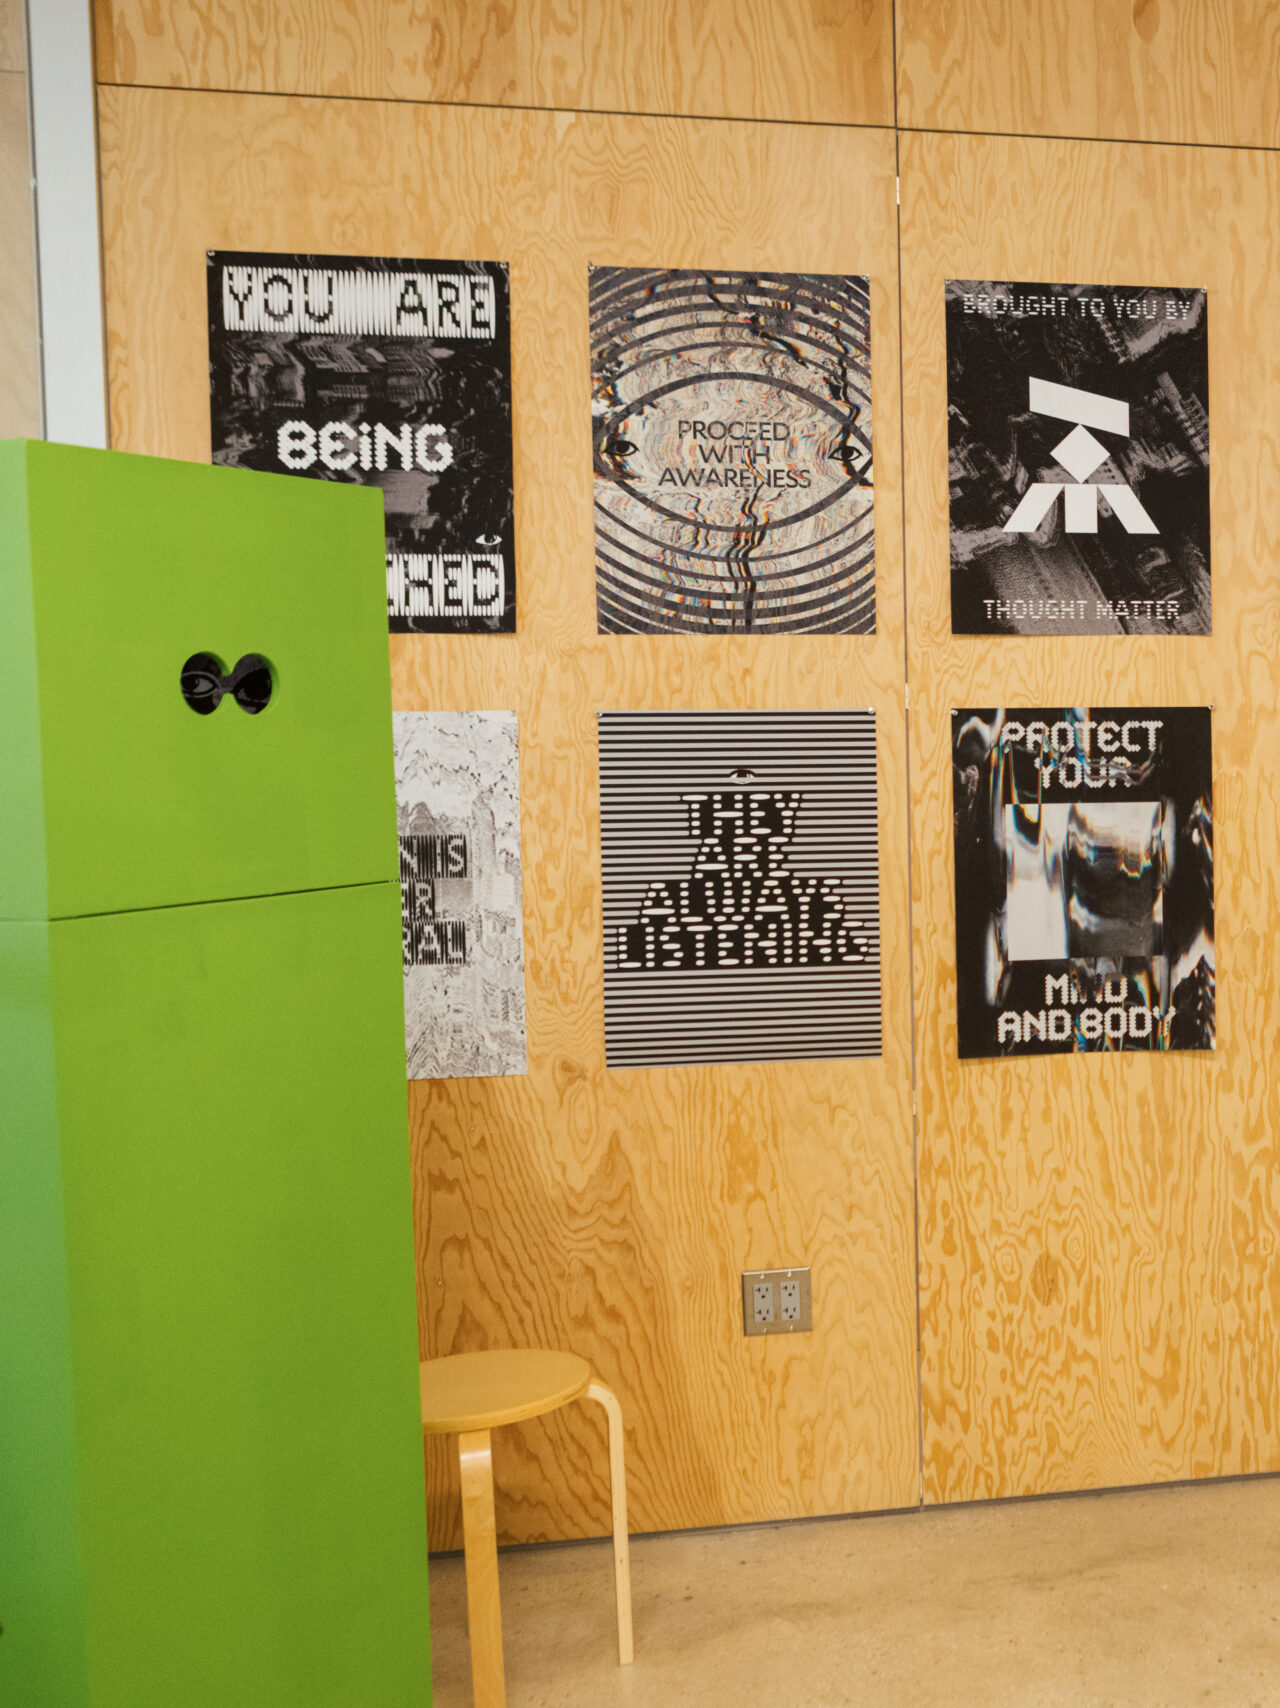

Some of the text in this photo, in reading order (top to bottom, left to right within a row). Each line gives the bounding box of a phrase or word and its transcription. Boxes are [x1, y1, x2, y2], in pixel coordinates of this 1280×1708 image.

[227, 267, 492, 331] YOU ARE
[963, 294, 1191, 321] BROUGHT TO YOU BY
[677, 420, 792, 442] PROCEED
[698, 444, 771, 465] WITH
[657, 467, 812, 490] AWARENESS
[983, 599, 1181, 621] THOUGHT MATTER
[1000, 720, 1164, 754] PROTECT
[1033, 755, 1132, 789] YOUR
[681, 793, 801, 836] THEY
[694, 836, 791, 879] ARE
[639, 878, 842, 923] ALWAYS
[617, 920, 869, 969] LISTENING
[997, 1005, 1177, 1044] AND BODY
